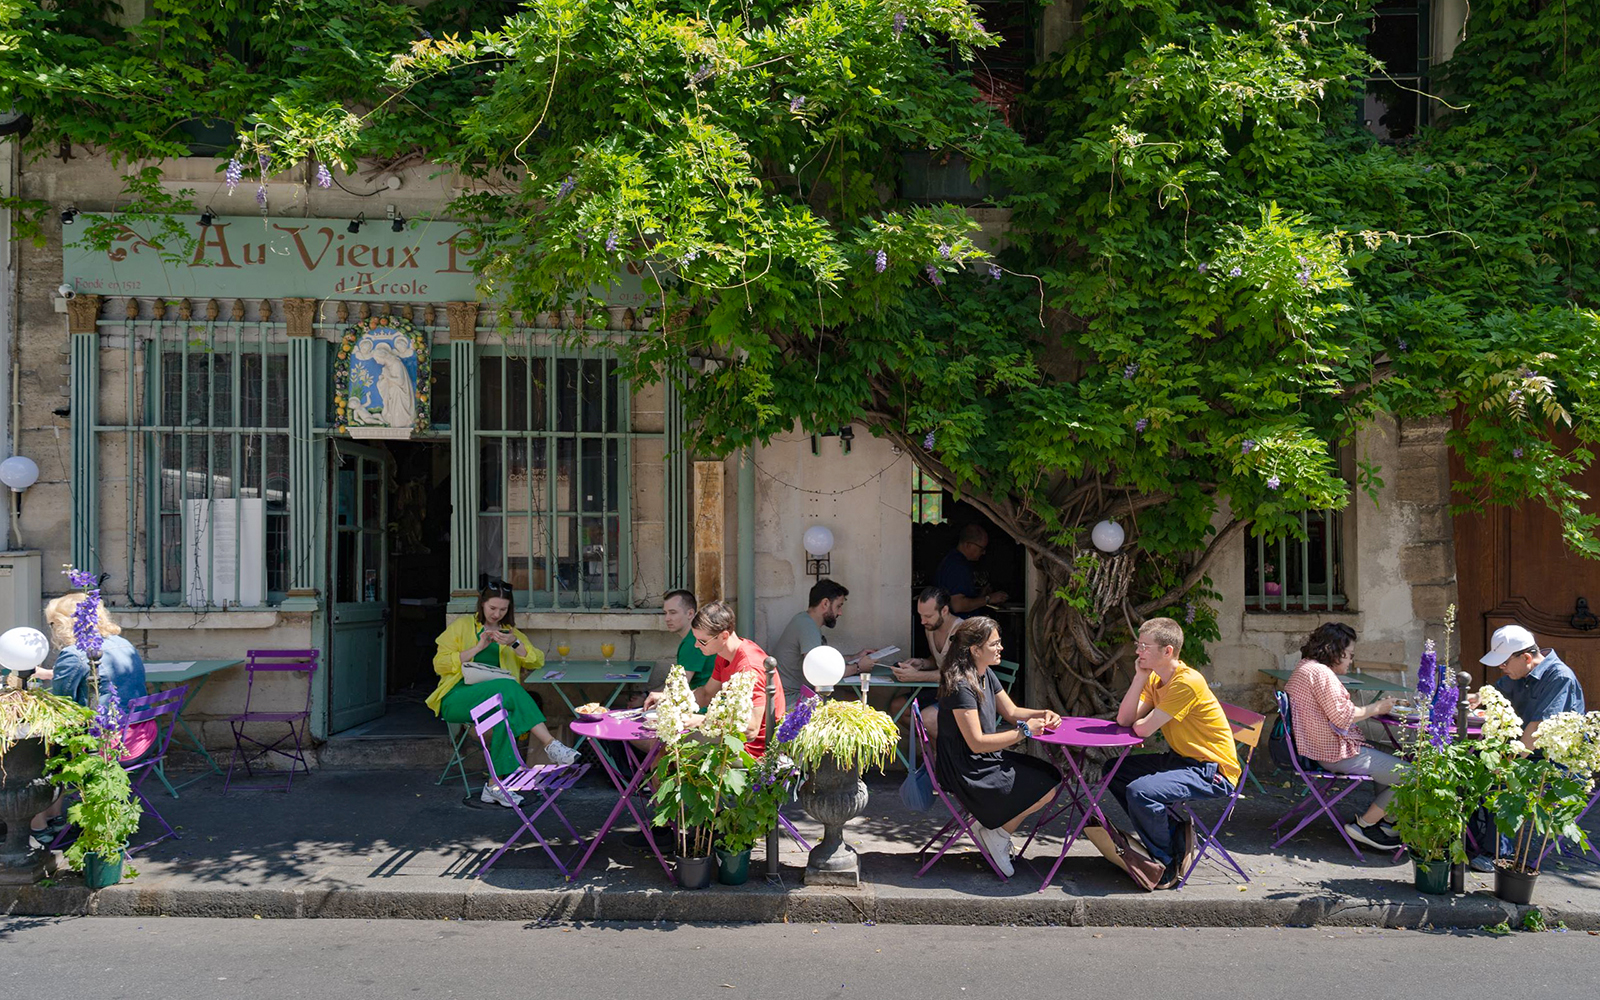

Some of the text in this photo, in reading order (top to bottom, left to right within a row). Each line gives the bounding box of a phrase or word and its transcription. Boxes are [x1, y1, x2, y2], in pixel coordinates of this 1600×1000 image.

[187, 221, 266, 269] Au
[272, 223, 420, 272] Vieux
[73, 277, 141, 292] Fondé en 1512
[334, 271, 428, 296] d'Arcole
